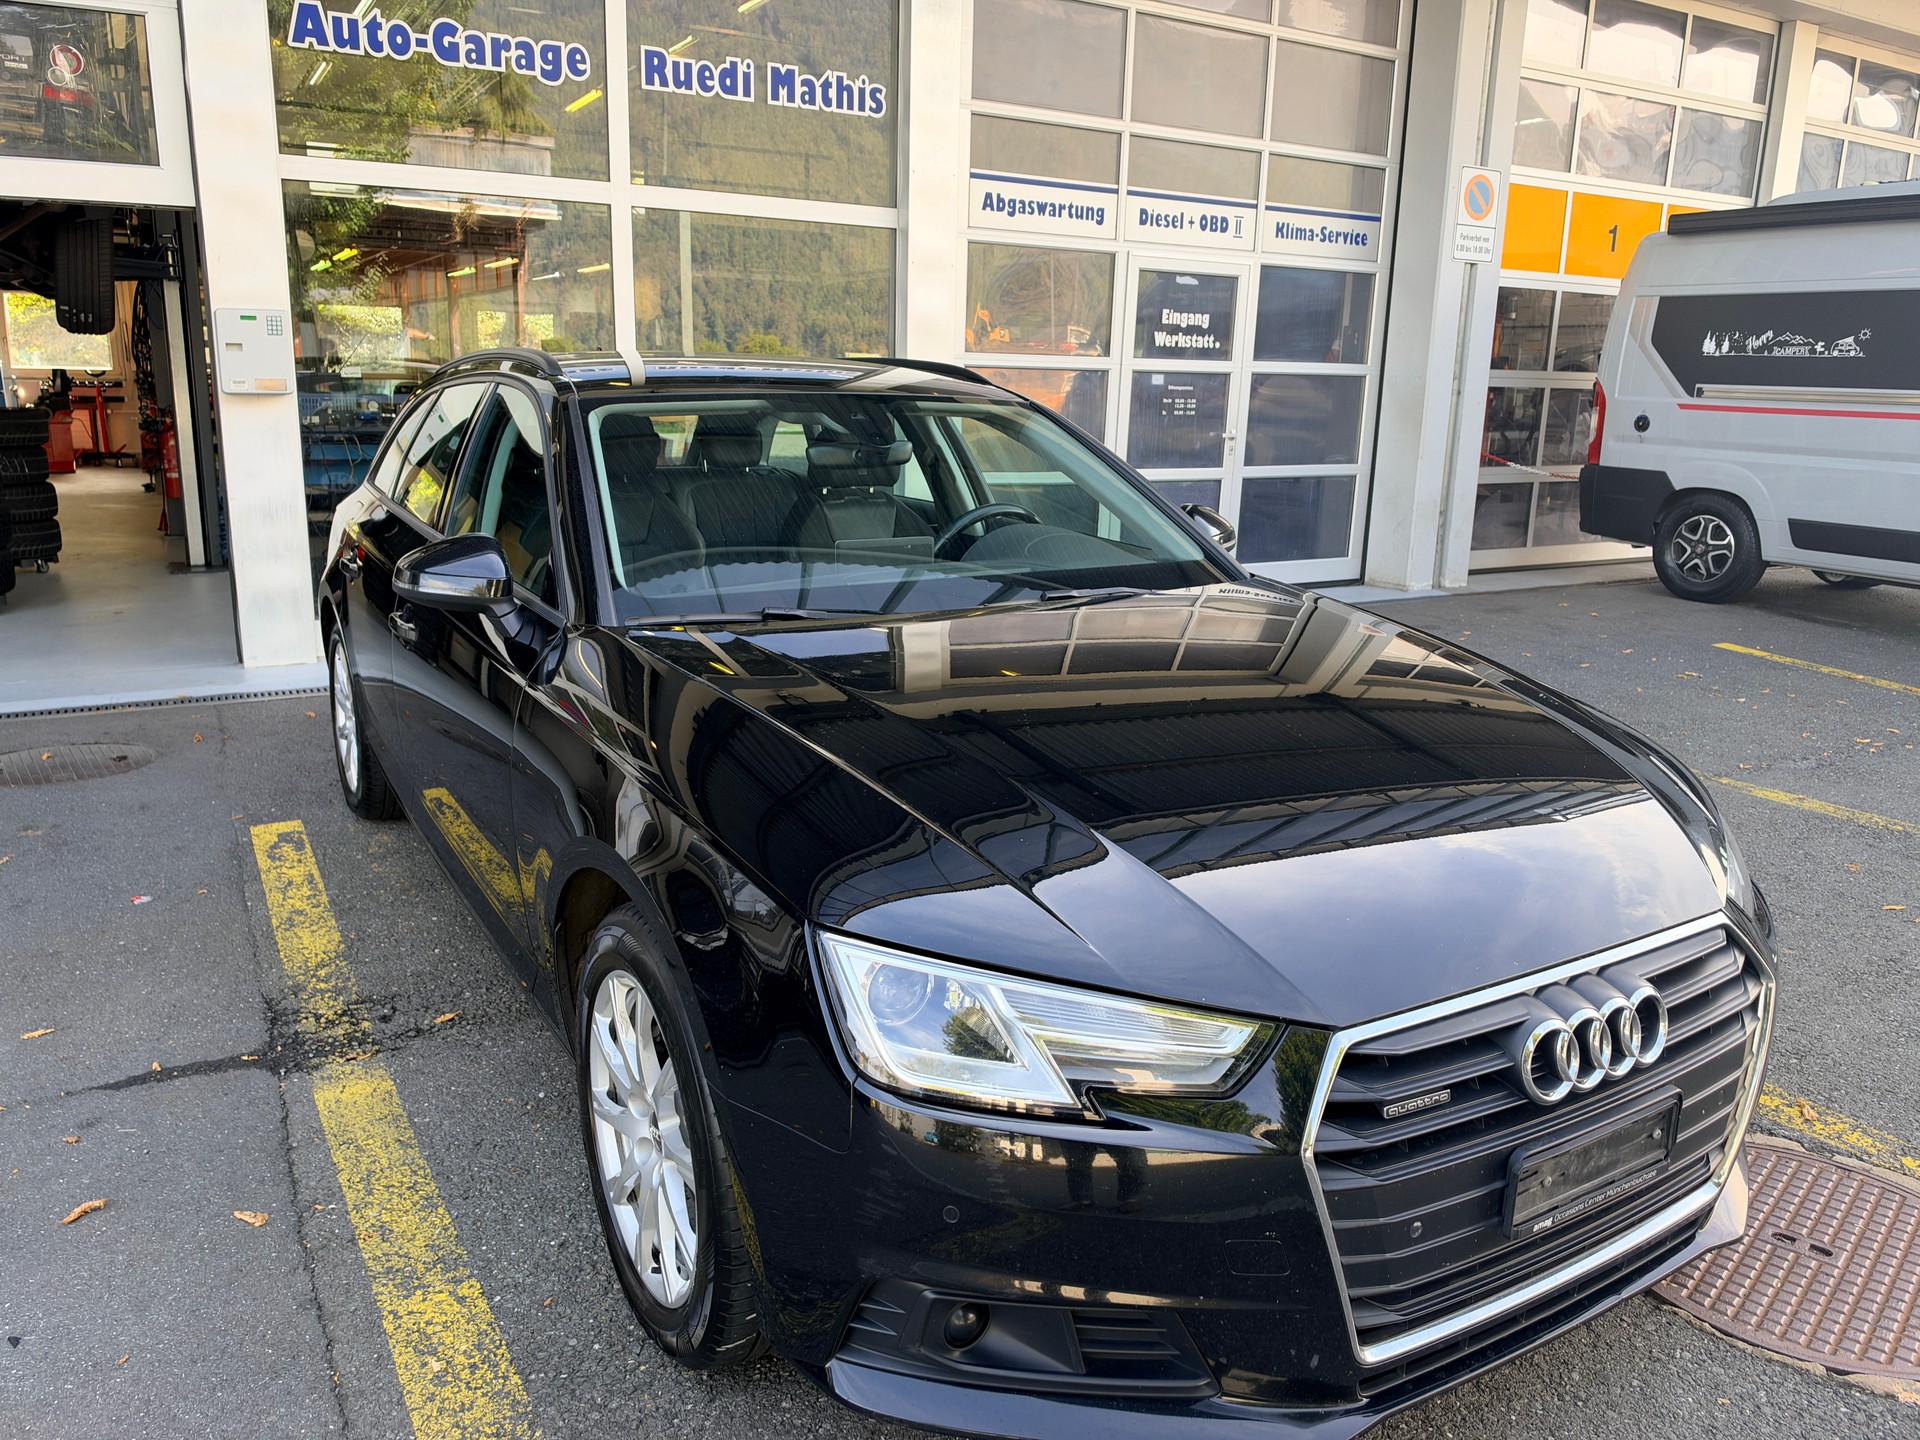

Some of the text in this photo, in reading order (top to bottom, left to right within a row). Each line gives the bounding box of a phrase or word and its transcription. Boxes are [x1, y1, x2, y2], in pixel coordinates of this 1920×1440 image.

[288, 0, 591, 86] Auto-Garage
[641, 45, 887, 118] Ruedi Mathis
[981, 192, 1105, 225] Abgaswartung
[1138, 207, 1184, 230] Diesel
[1199, 214, 1229, 234] OBD
[1275, 221, 1368, 247] Klima-Service
[1608, 224, 1618, 252] 1
[1162, 309, 1210, 329] Eingang
[1775, 347, 1806, 355] CAMPER
[1388, 1093, 1449, 1116] quattro
